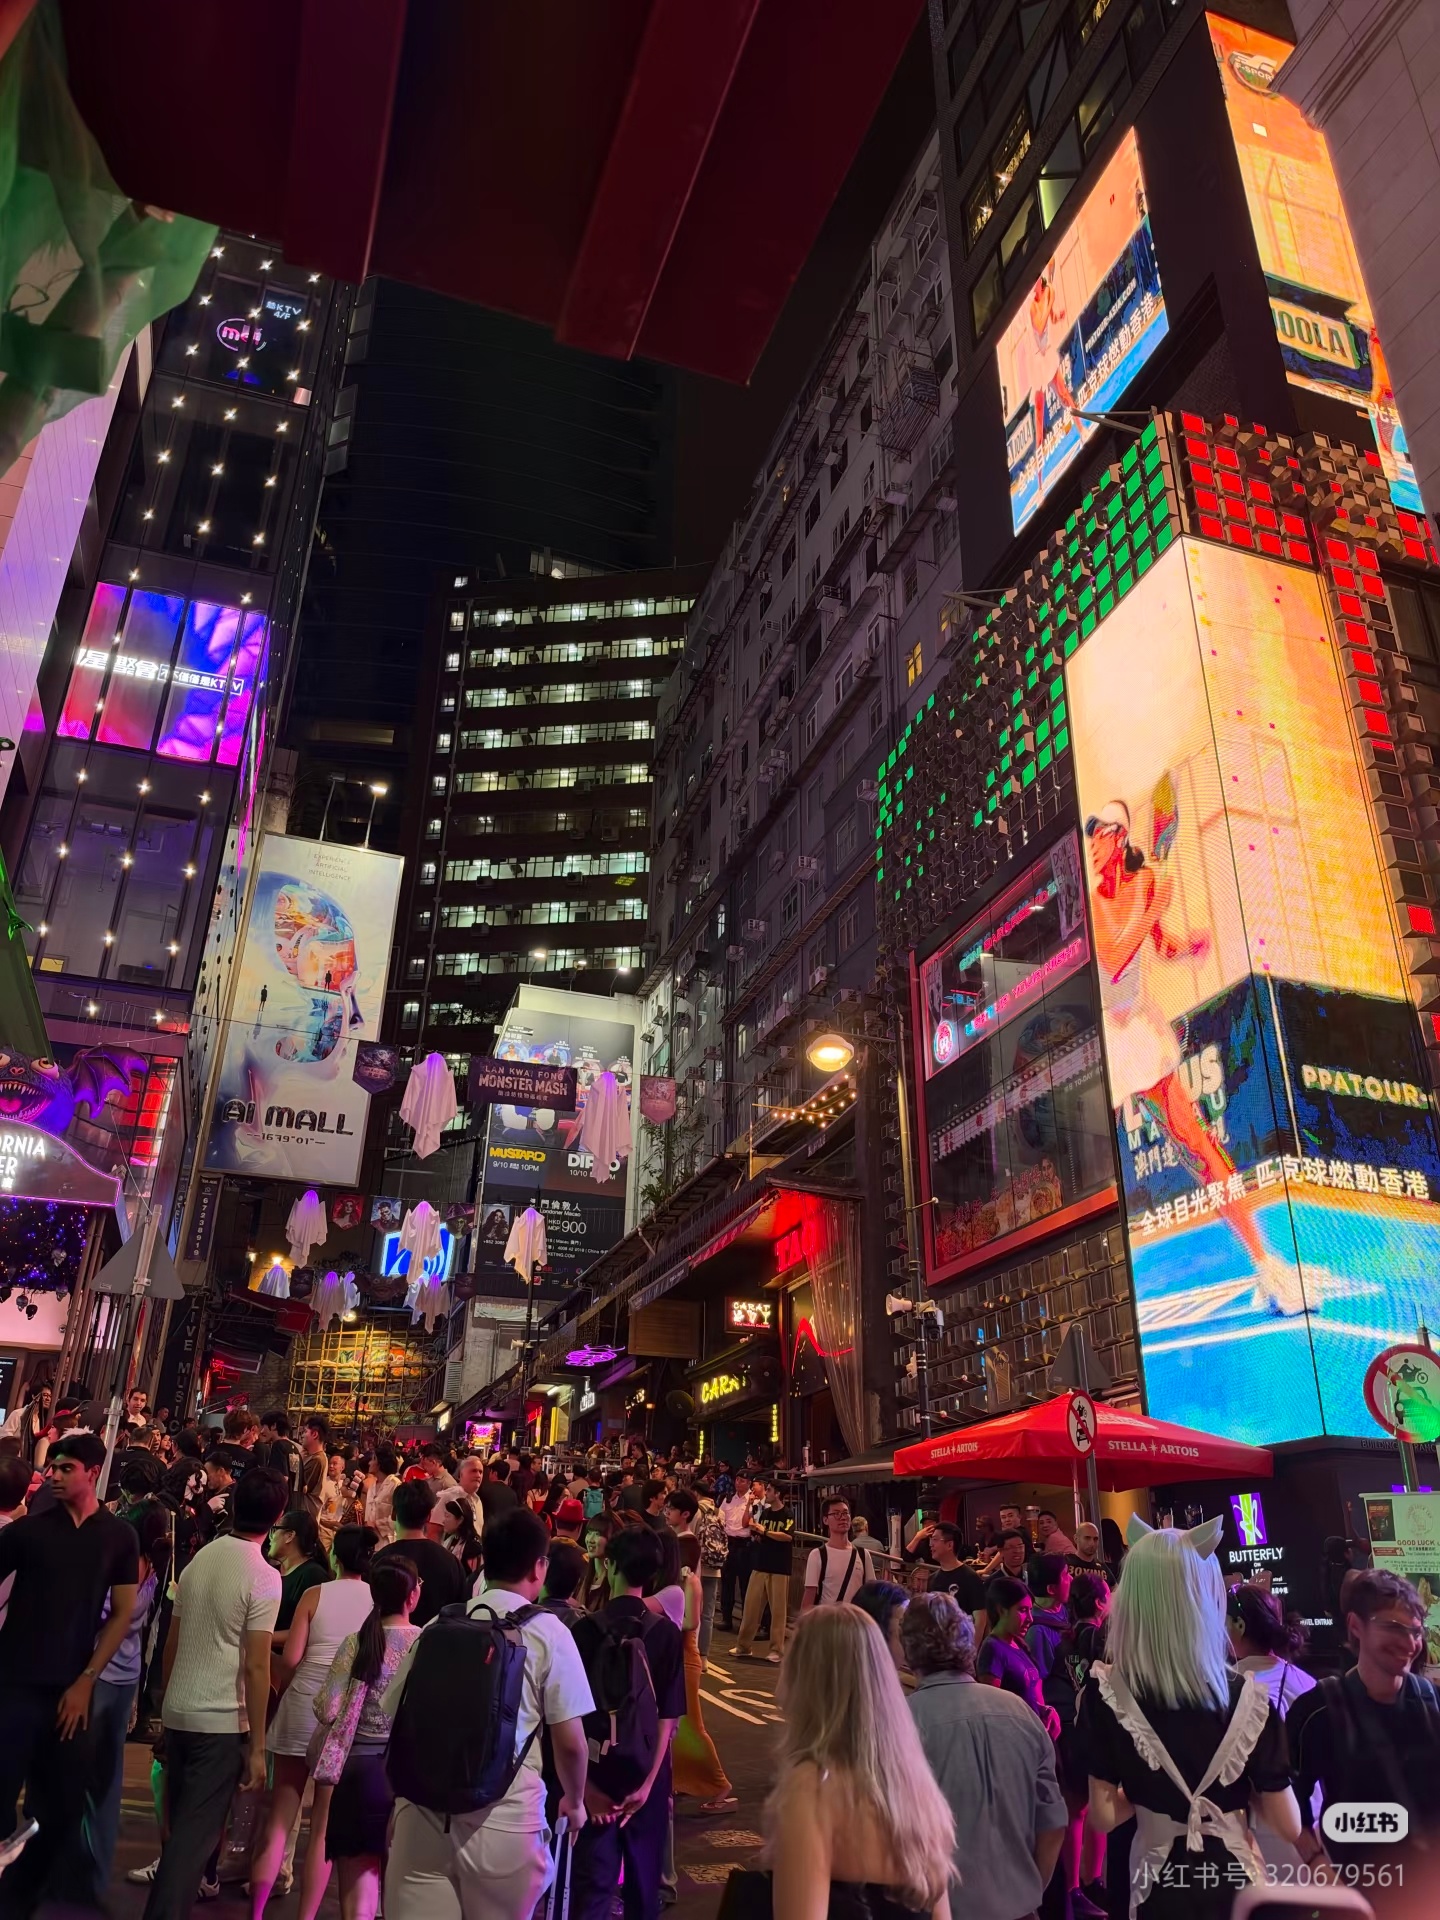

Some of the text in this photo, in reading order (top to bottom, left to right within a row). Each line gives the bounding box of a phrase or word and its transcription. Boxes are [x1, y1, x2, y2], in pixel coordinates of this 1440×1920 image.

[485, 1065, 564, 1081] LAN KWAI FONG
[478, 1073, 568, 1096] MONSTER MASH
[222, 1098, 354, 1136] AI MALL
[489, 1146, 546, 1163] MUSTARD
[567, 1153, 620, 1173] DIPO
[492, 1160, 508, 1169] 9/10
[569, 1168, 588, 1178] 10/10
[1256, 1153, 1430, 1201] 匹克球燃動香港
[1140, 1172, 1247, 1237] 全球目光聚焦
[561, 1220, 587, 1235] 900
[733, 1301, 771, 1312] CARAT
[183, 1294, 200, 1352] LIVE
[930, 1441, 978, 1459] STELLA ARTOIS
[1107, 1440, 1200, 1457] STELLA ARTOIS
[1229, 1546, 1284, 1563] BUTTERFLY
